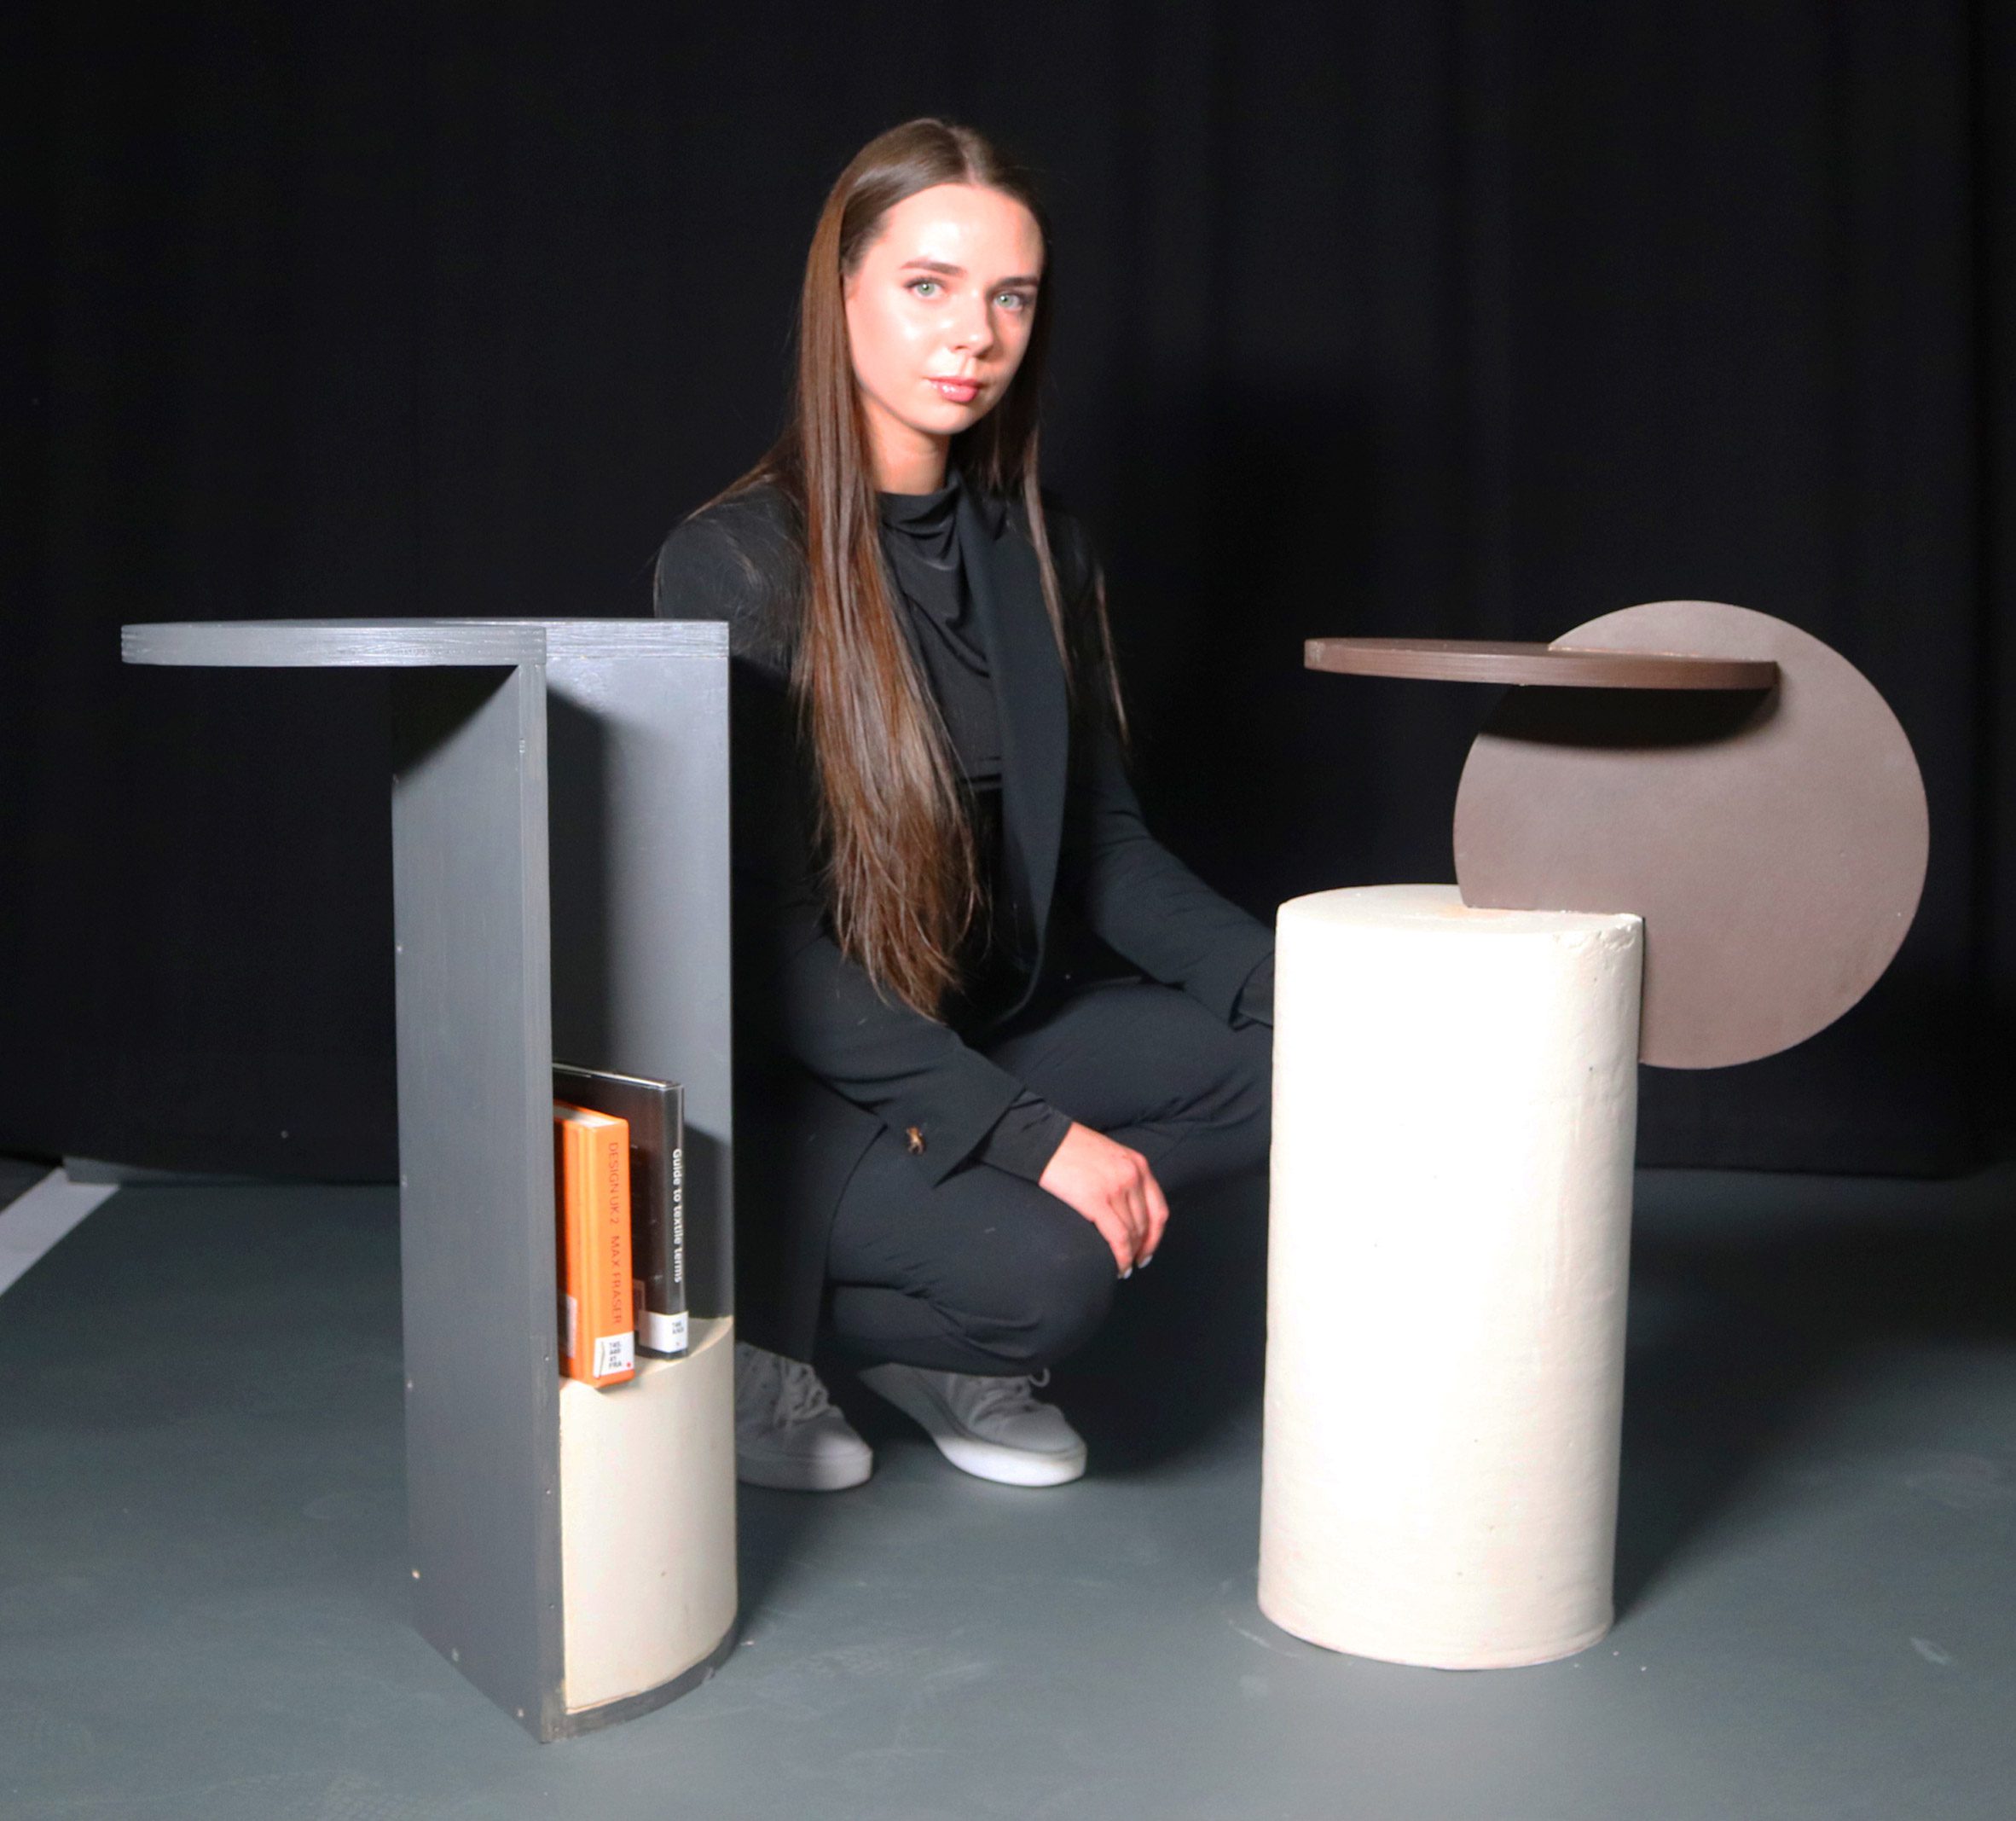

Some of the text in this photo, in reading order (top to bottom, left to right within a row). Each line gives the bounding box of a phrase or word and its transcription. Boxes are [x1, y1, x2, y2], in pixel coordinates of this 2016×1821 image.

[609, 1142, 619, 1193] DESIGN
[610, 1196, 620, 1215] UK
[673, 1148, 683, 1284] Guide to textile terms
[611, 1235, 621, 1268] MAX
[612, 1272, 622, 1324] FRASER
